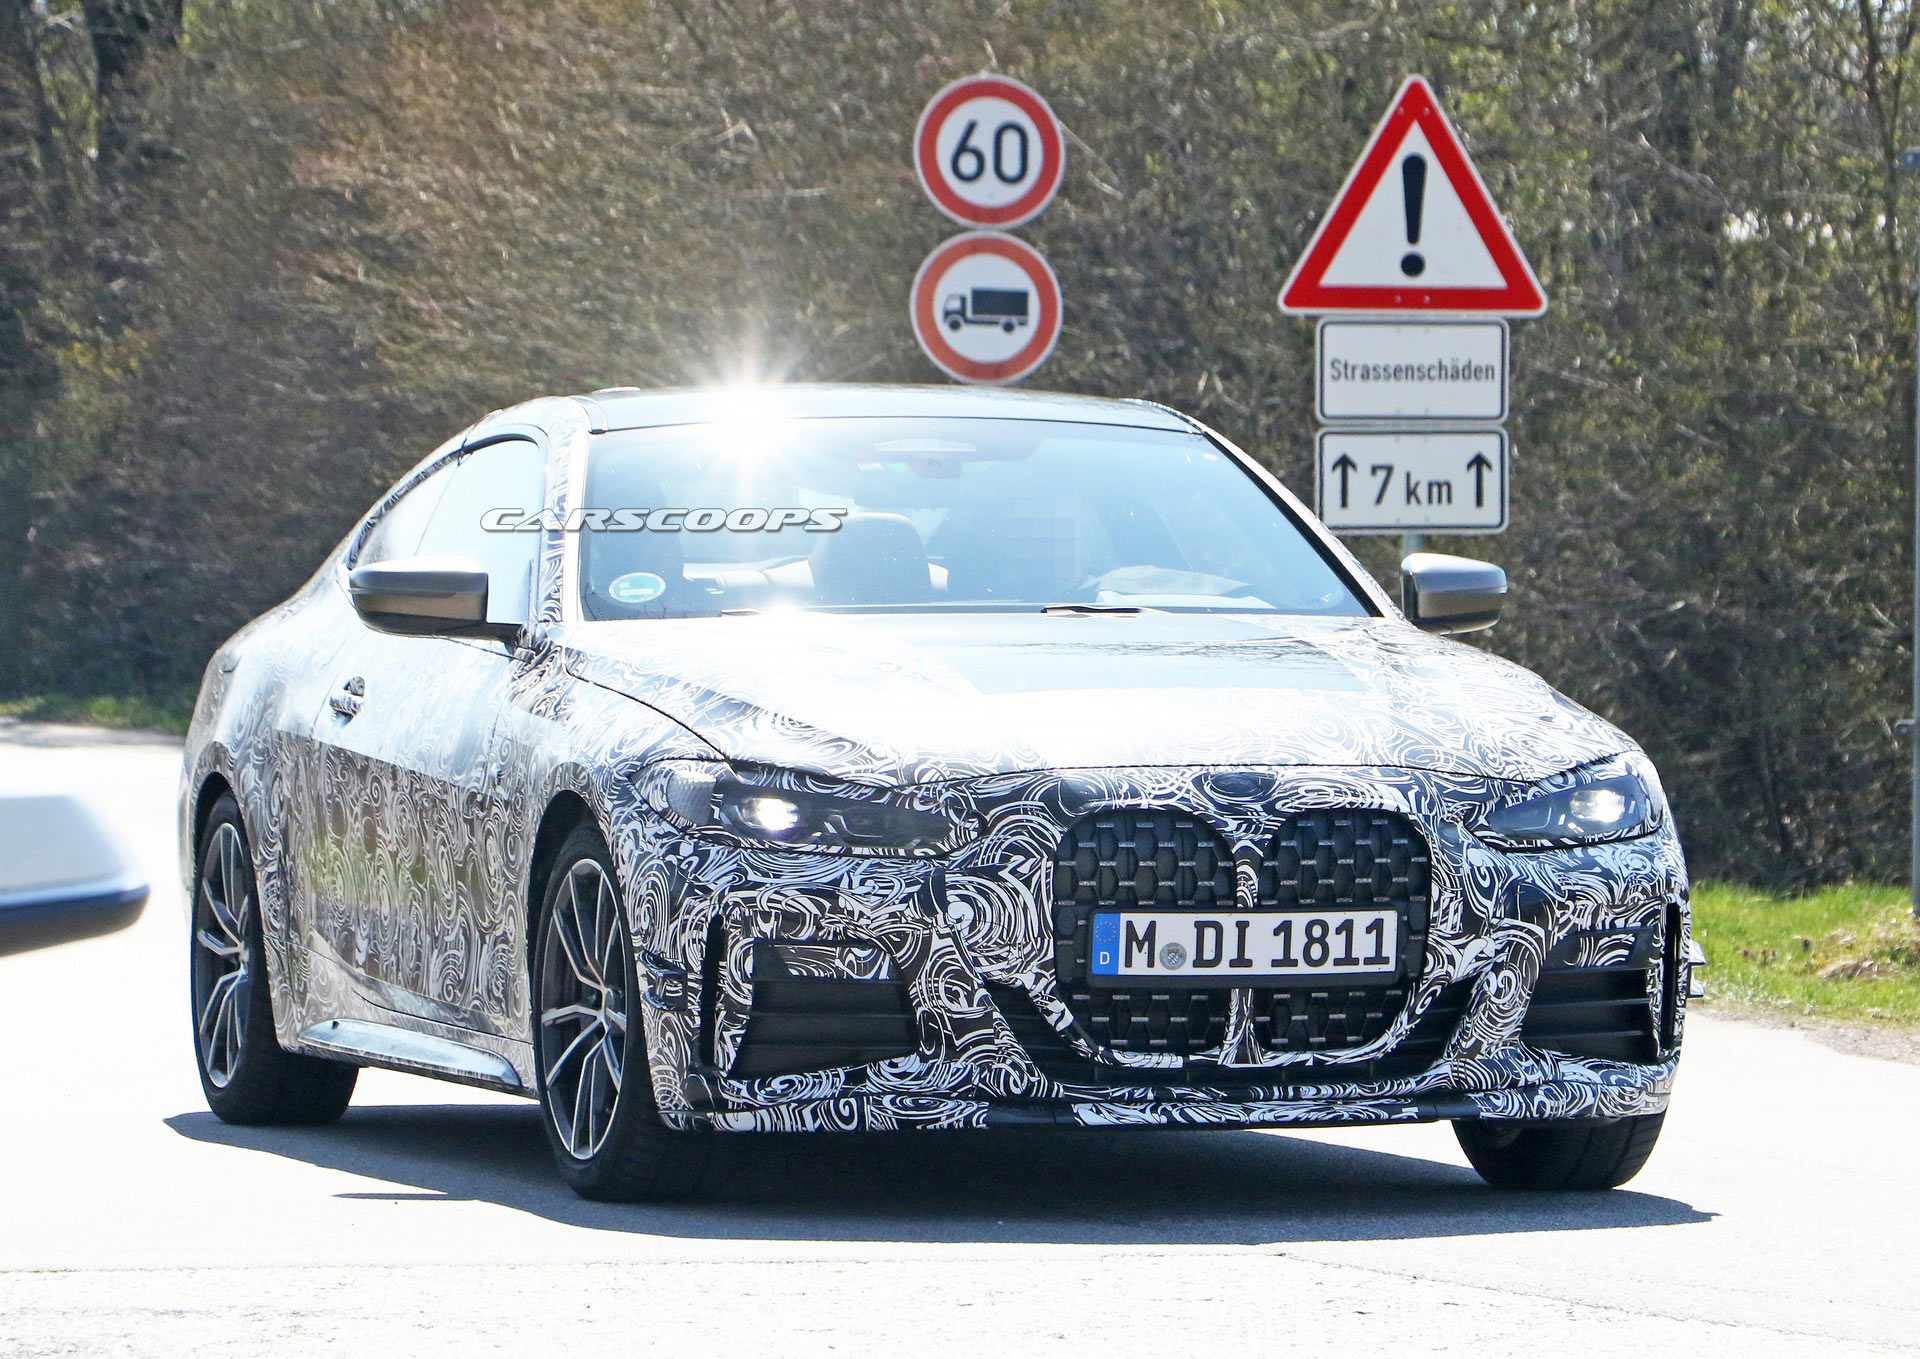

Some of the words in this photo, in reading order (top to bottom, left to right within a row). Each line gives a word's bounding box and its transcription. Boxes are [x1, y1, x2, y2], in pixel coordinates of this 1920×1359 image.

[951, 120, 1028, 184] 60
[1330, 357, 1496, 382] Strassenschäden
[1370, 463, 1395, 506] 7
[1405, 470, 1453, 506] km
[1100, 951, 1111, 965] D
[1124, 920, 1156, 968] M
[1192, 920, 1253, 968] DI
[1270, 917, 1390, 968] 1811
